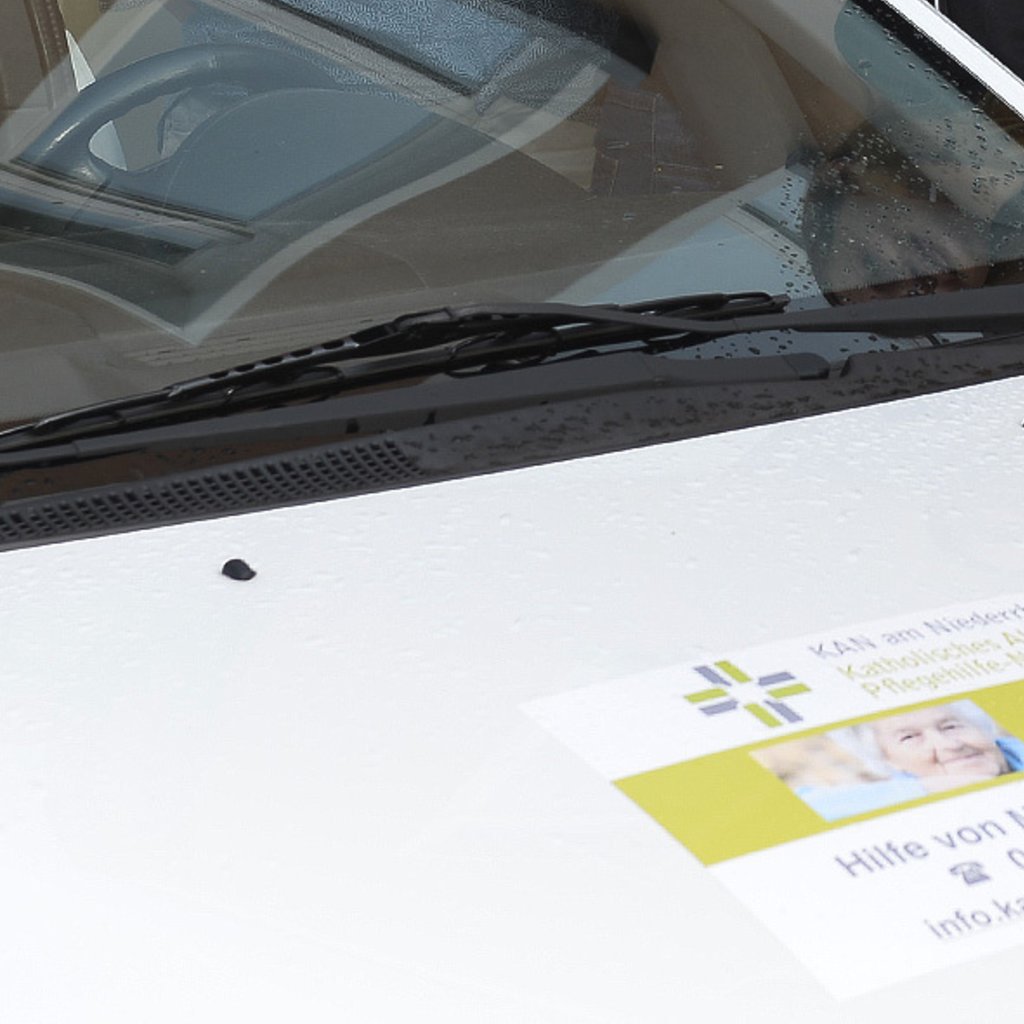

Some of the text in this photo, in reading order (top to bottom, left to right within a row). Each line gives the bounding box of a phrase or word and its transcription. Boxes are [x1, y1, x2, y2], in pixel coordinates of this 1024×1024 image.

[808, 635, 876, 660] KAN
[880, 628, 925, 645] am
[836, 638, 1002, 680] Katholisches
[834, 839, 929, 877] Hilfe
[932, 819, 1007, 849] von
